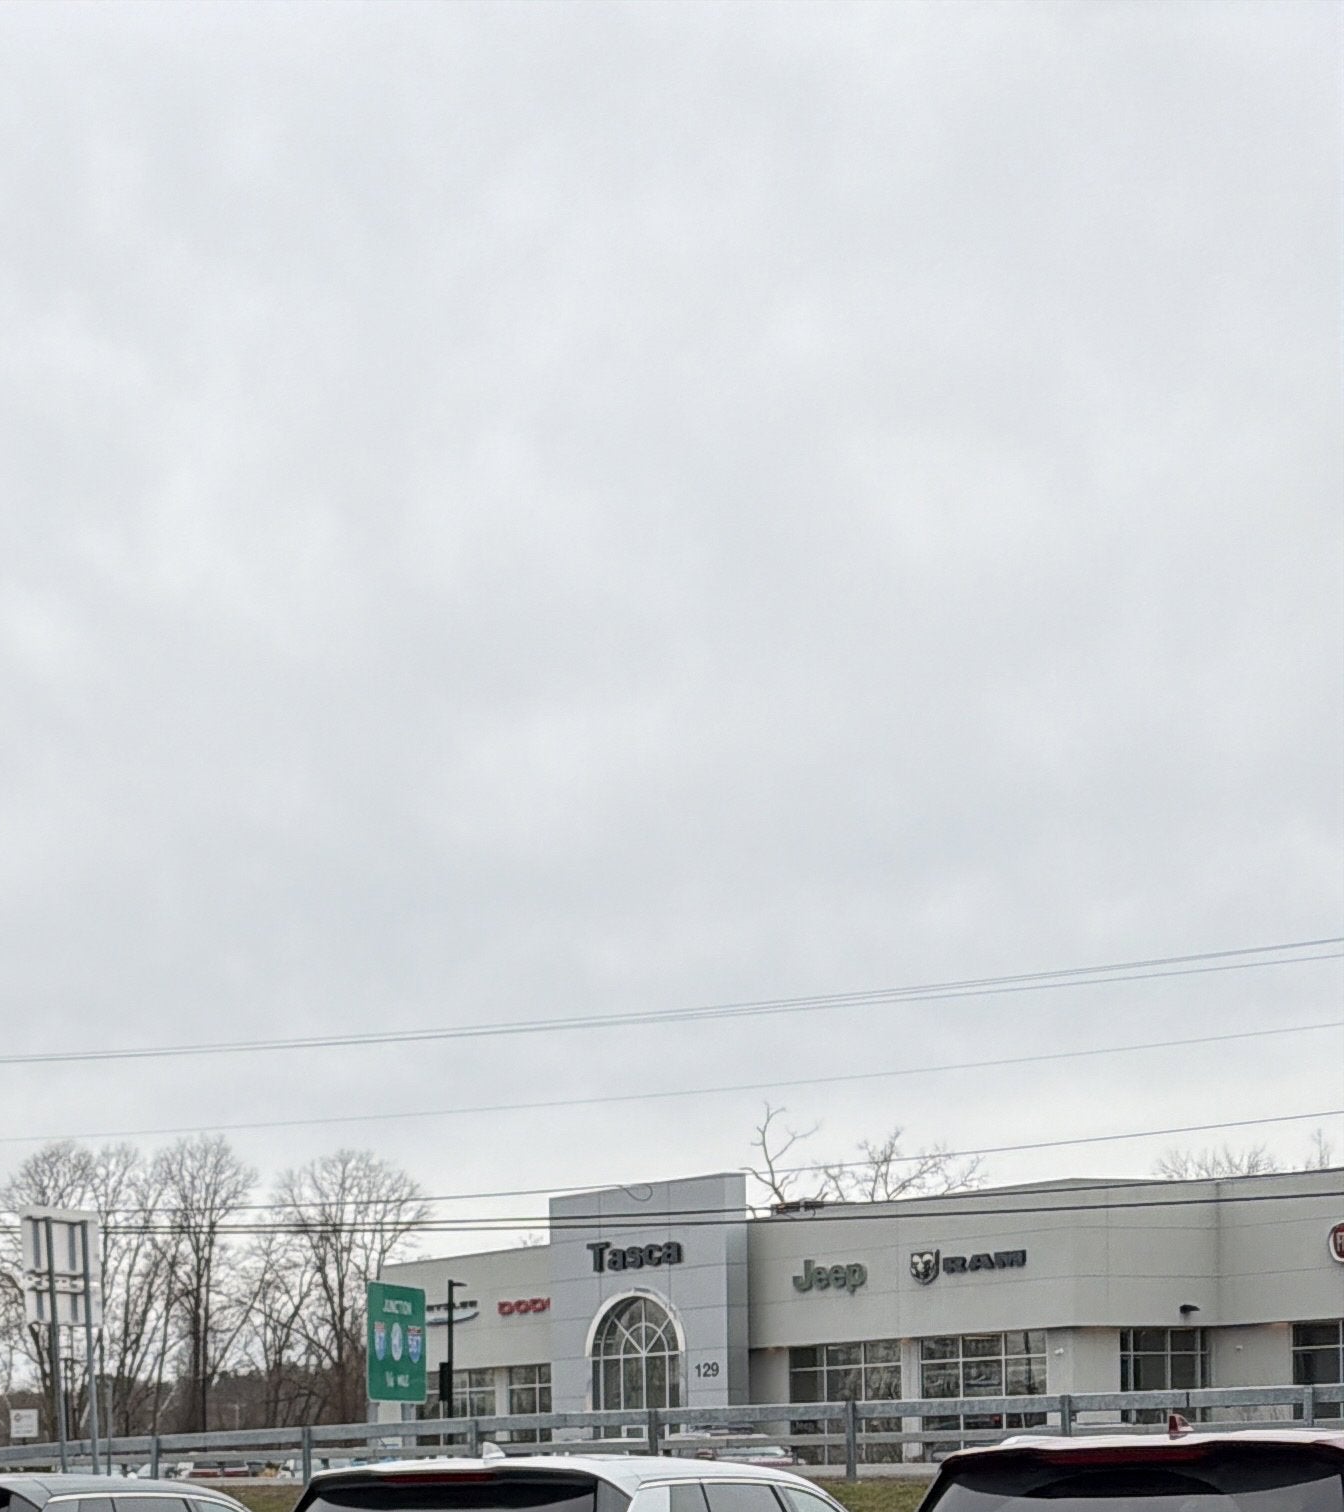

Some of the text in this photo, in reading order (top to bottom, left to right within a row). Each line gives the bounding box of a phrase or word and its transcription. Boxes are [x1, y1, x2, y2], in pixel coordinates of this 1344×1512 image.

[586, 1241, 685, 1273] Tasca
[792, 1249, 1027, 1296] Jeep RAM
[695, 1362, 720, 1378] 129
